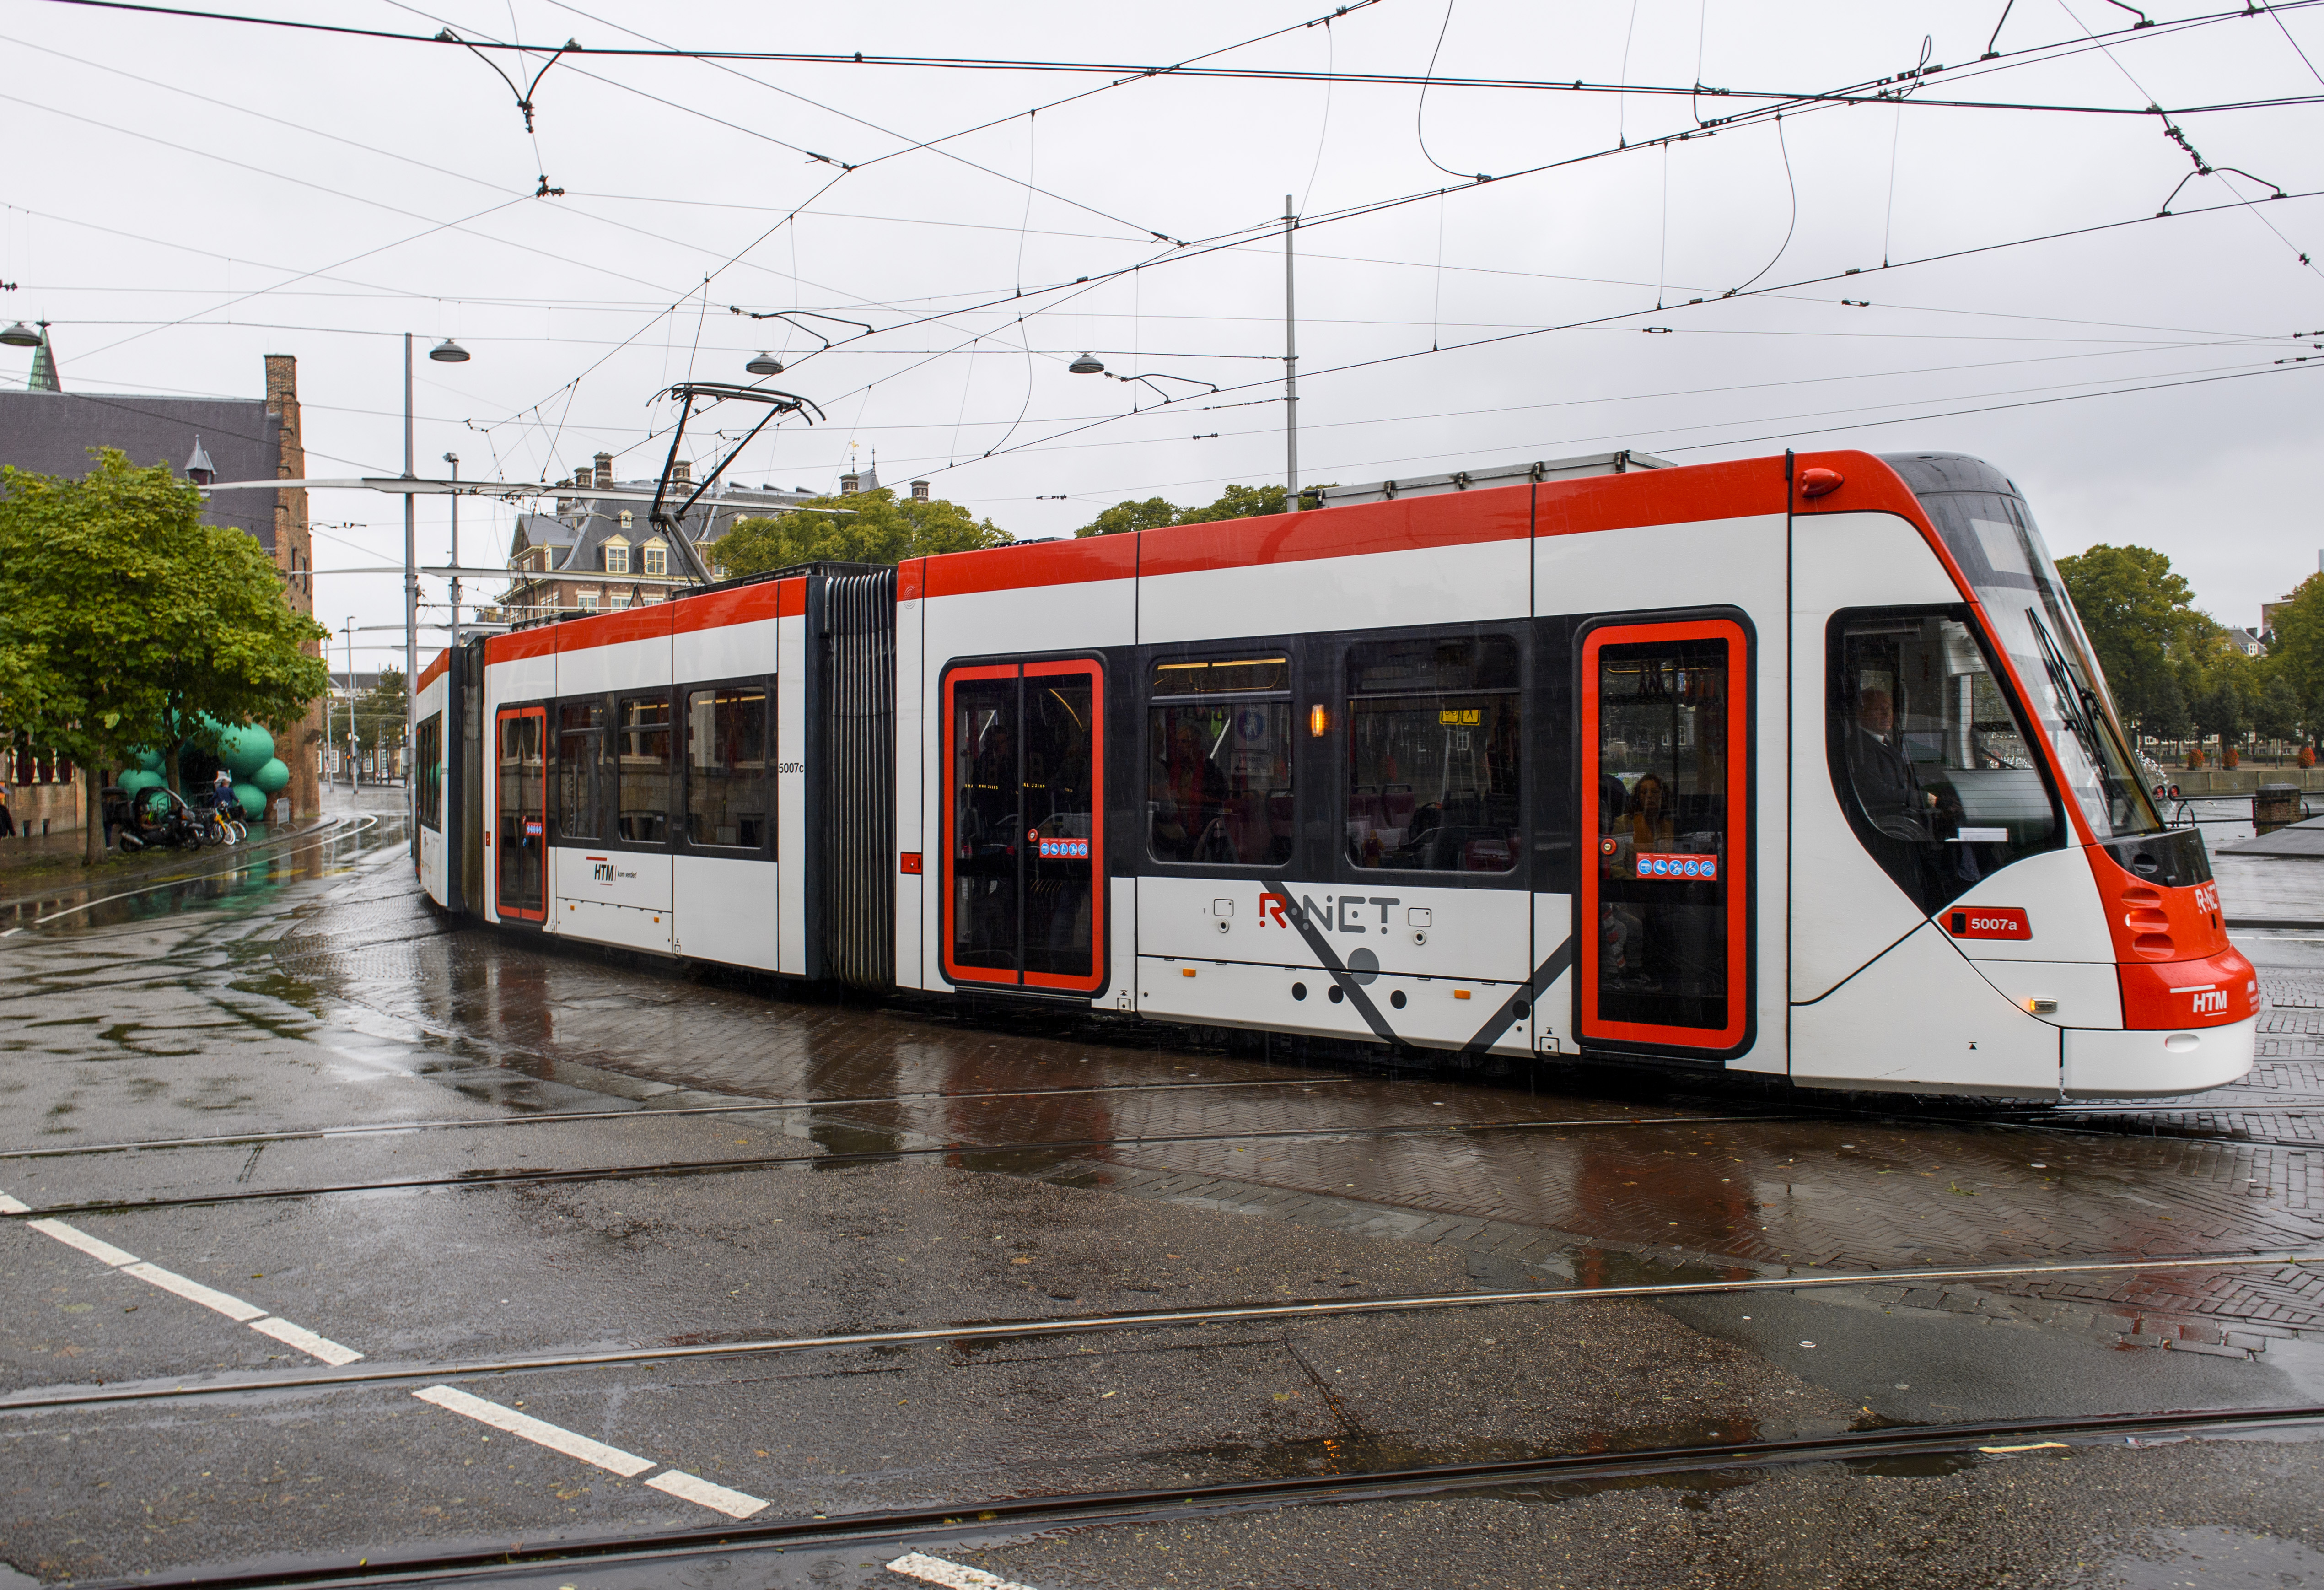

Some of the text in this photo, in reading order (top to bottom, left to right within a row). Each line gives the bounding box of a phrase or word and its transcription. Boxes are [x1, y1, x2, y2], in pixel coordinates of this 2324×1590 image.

[779, 762, 804, 773] 5007c
[595, 864, 614, 881] HTM
[1971, 918, 2017, 930] 5007a
[2193, 990, 2227, 1013] HTM
